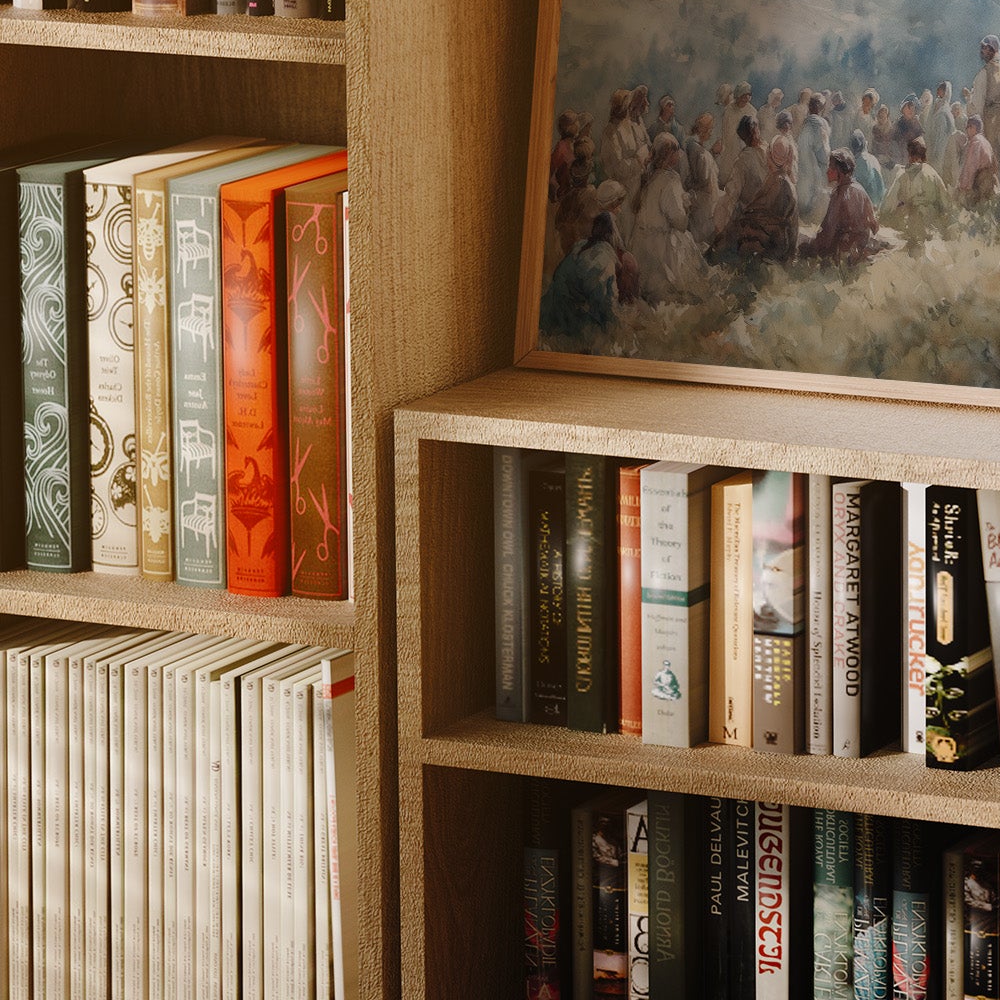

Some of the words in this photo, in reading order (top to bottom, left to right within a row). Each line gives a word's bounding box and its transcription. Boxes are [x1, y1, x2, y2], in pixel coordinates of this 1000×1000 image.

[833, 492, 846, 543] ORYX
[845, 493, 860, 606] MARGARET
[833, 549, 845, 593] AND
[833, 599, 845, 669] CRAKE
[845, 611, 860, 698] ATWOOD
[711, 797, 722, 865] DELVAU
[711, 873, 722, 915] PAUL
